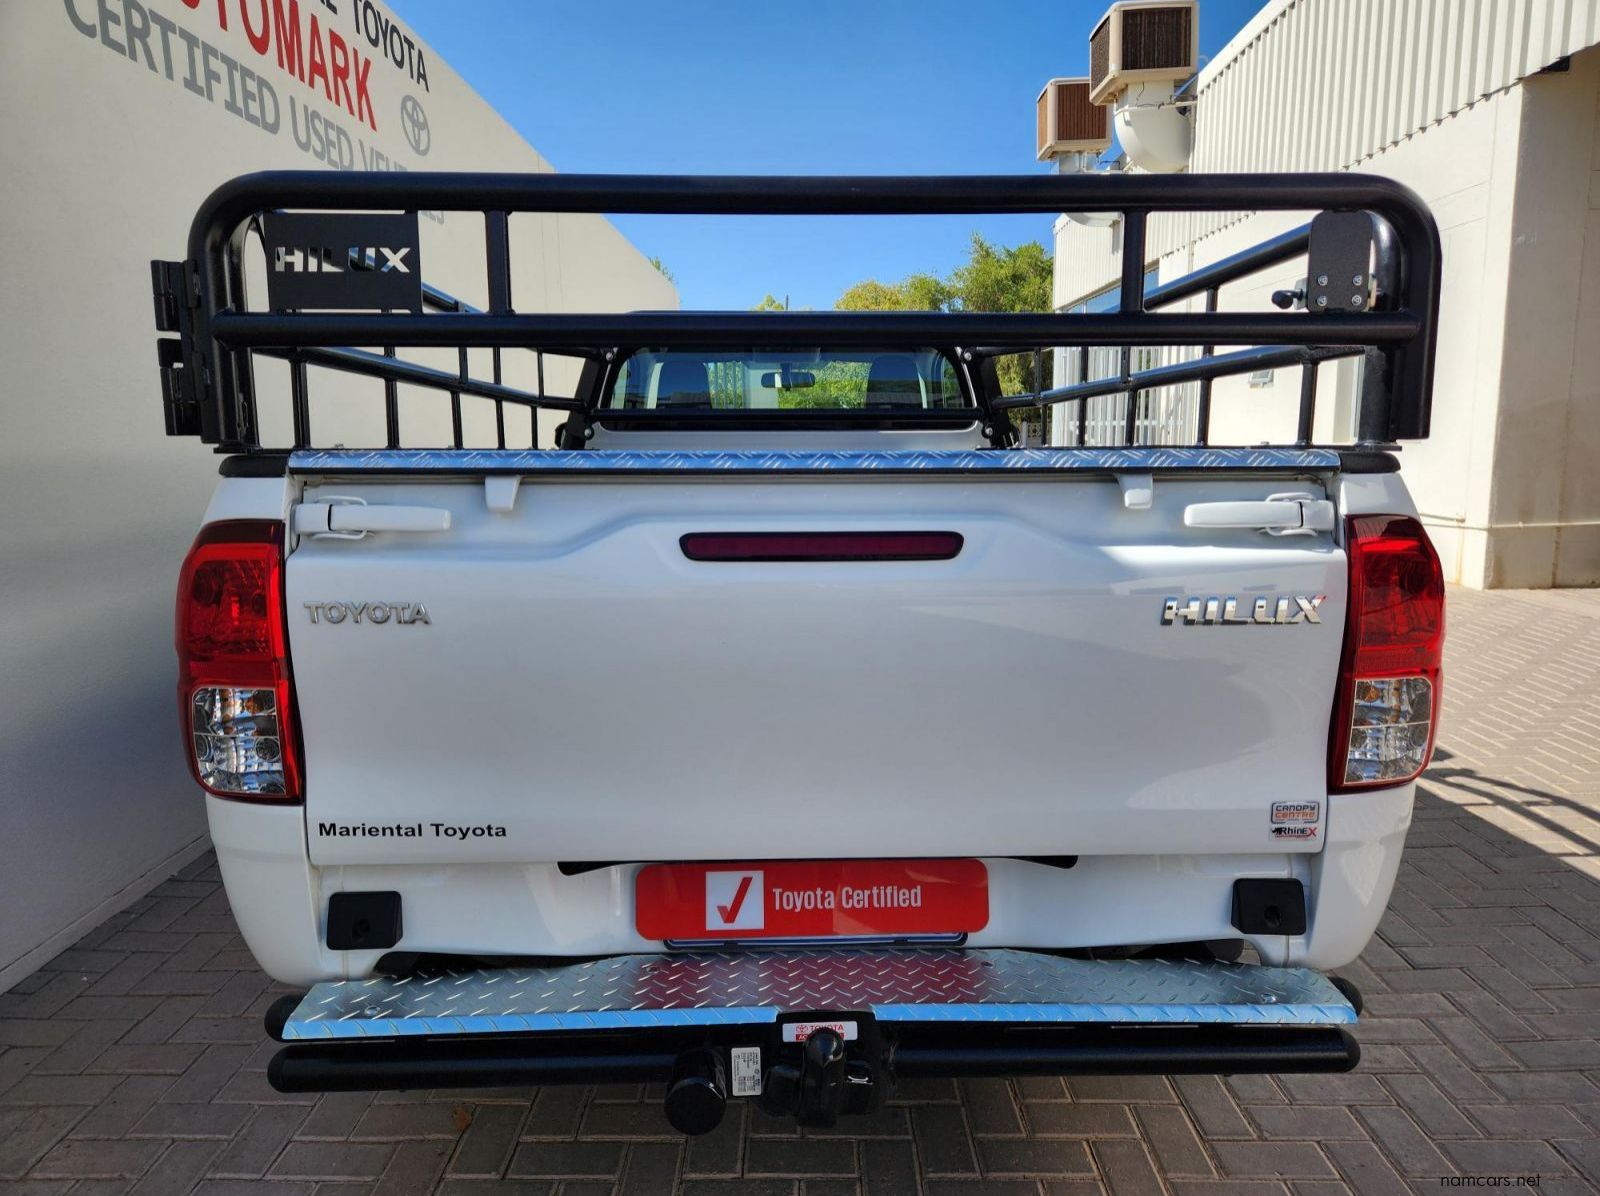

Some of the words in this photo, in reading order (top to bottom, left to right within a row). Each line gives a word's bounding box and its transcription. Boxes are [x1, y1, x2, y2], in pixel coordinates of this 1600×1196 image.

[352, 0, 430, 93] TOYOTA
[289, 95, 354, 171] USED
[275, 247, 411, 272] HILUX
[303, 601, 432, 624] TOYOTA
[1161, 595, 1326, 625] HILUX
[319, 823, 422, 837] Mariental
[430, 823, 507, 840] Toyota
[773, 888, 835, 911] Toyota
[842, 886, 922, 909] Certified
